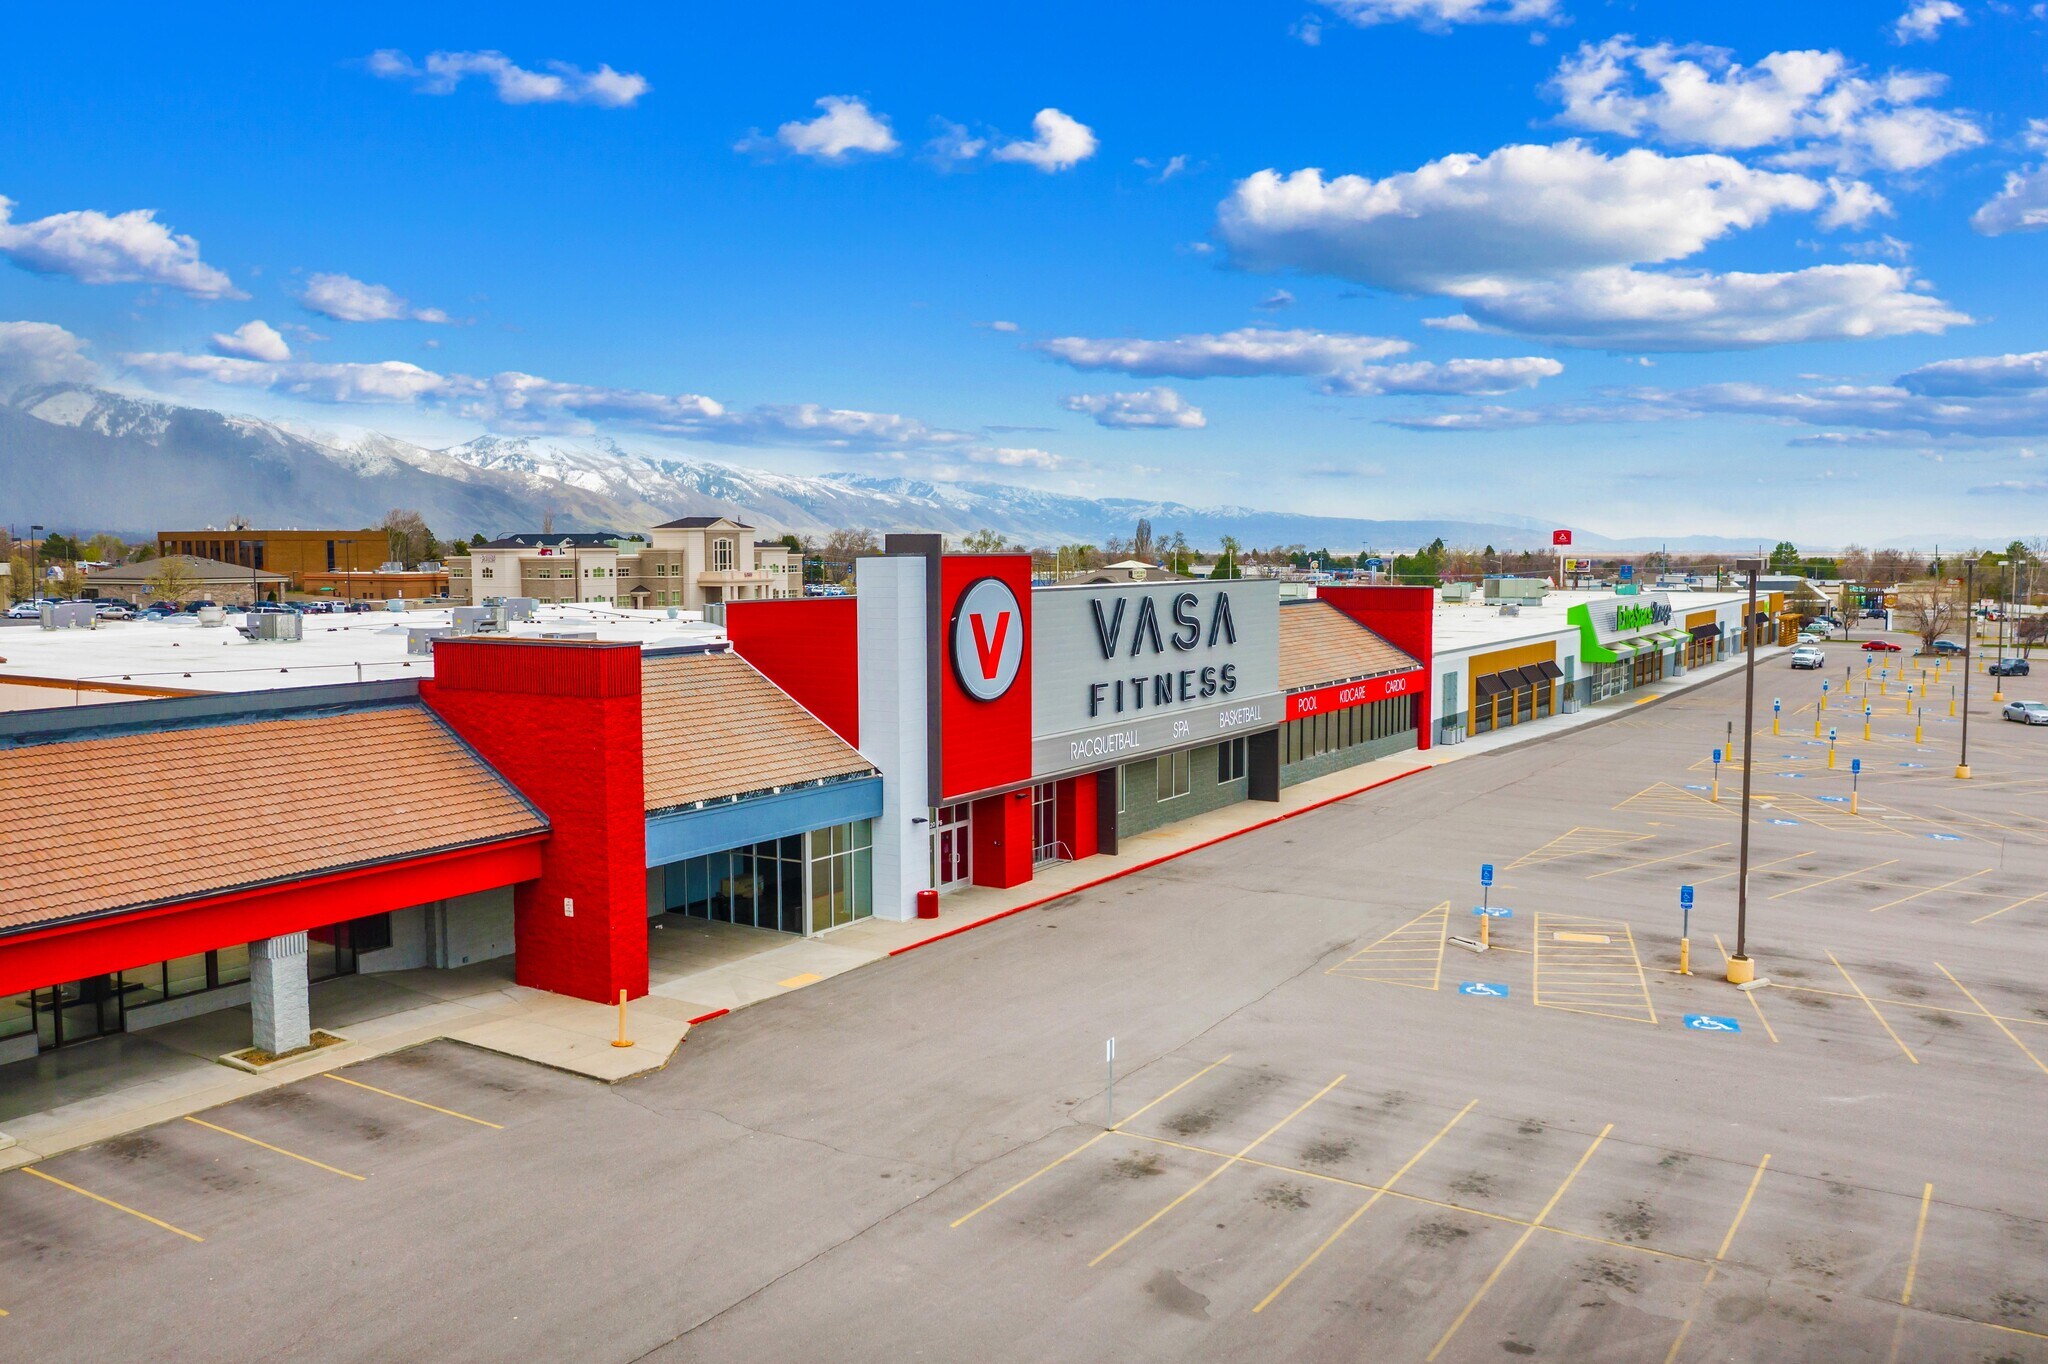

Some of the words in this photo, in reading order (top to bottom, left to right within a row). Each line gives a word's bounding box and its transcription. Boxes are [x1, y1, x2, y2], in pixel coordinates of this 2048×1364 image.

[969, 611, 1011, 680] V
[1093, 591, 1237, 659] VASA
[1091, 663, 1237, 717] FITNESS
[1298, 696, 1317, 712] POOL
[1339, 685, 1365, 703] KIDCARE
[1385, 678, 1406, 694] CARDIO
[1070, 730, 1139, 761] RACQUETBALL
[1173, 720, 1190, 739] SPA
[1219, 705, 1262, 728] BASKETBALL
